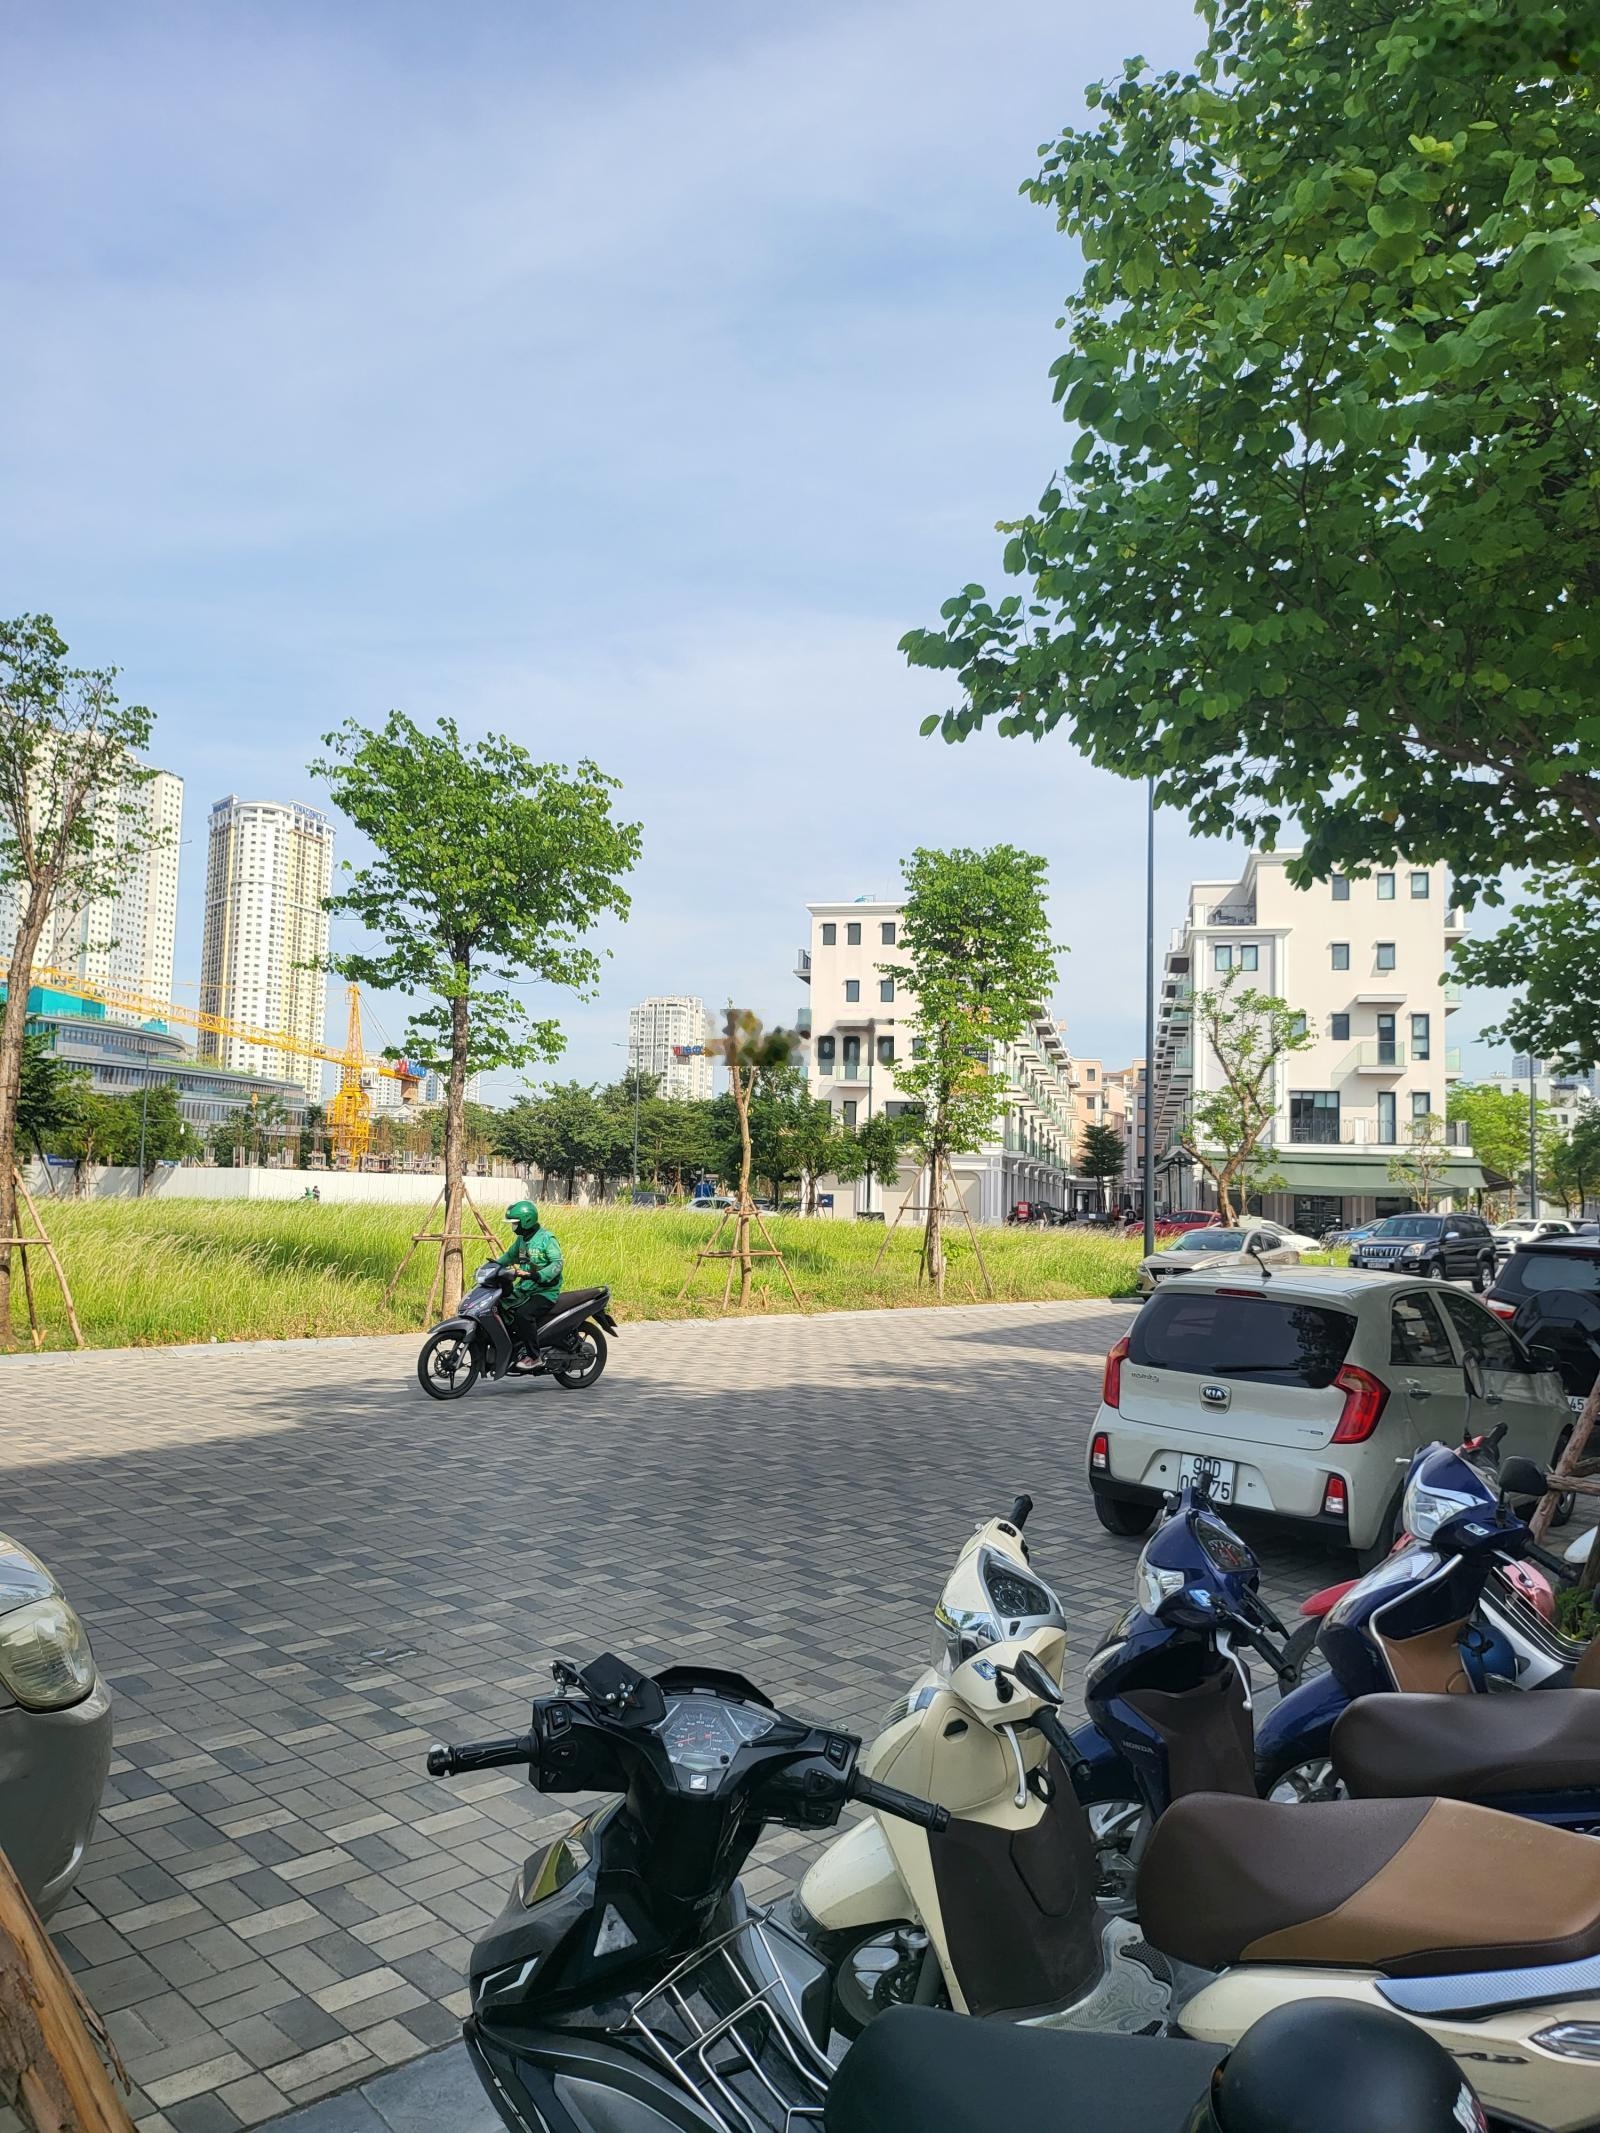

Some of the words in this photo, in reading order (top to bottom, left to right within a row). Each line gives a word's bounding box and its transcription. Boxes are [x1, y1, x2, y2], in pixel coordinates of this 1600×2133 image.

[1205, 1388, 1223, 1399] KIA
[1570, 1397, 1585, 1411] 45
[1192, 1457, 1222, 1479] 90D
[1180, 1474, 1231, 1501] 075
[1120, 1739, 1155, 1754] HONDA
